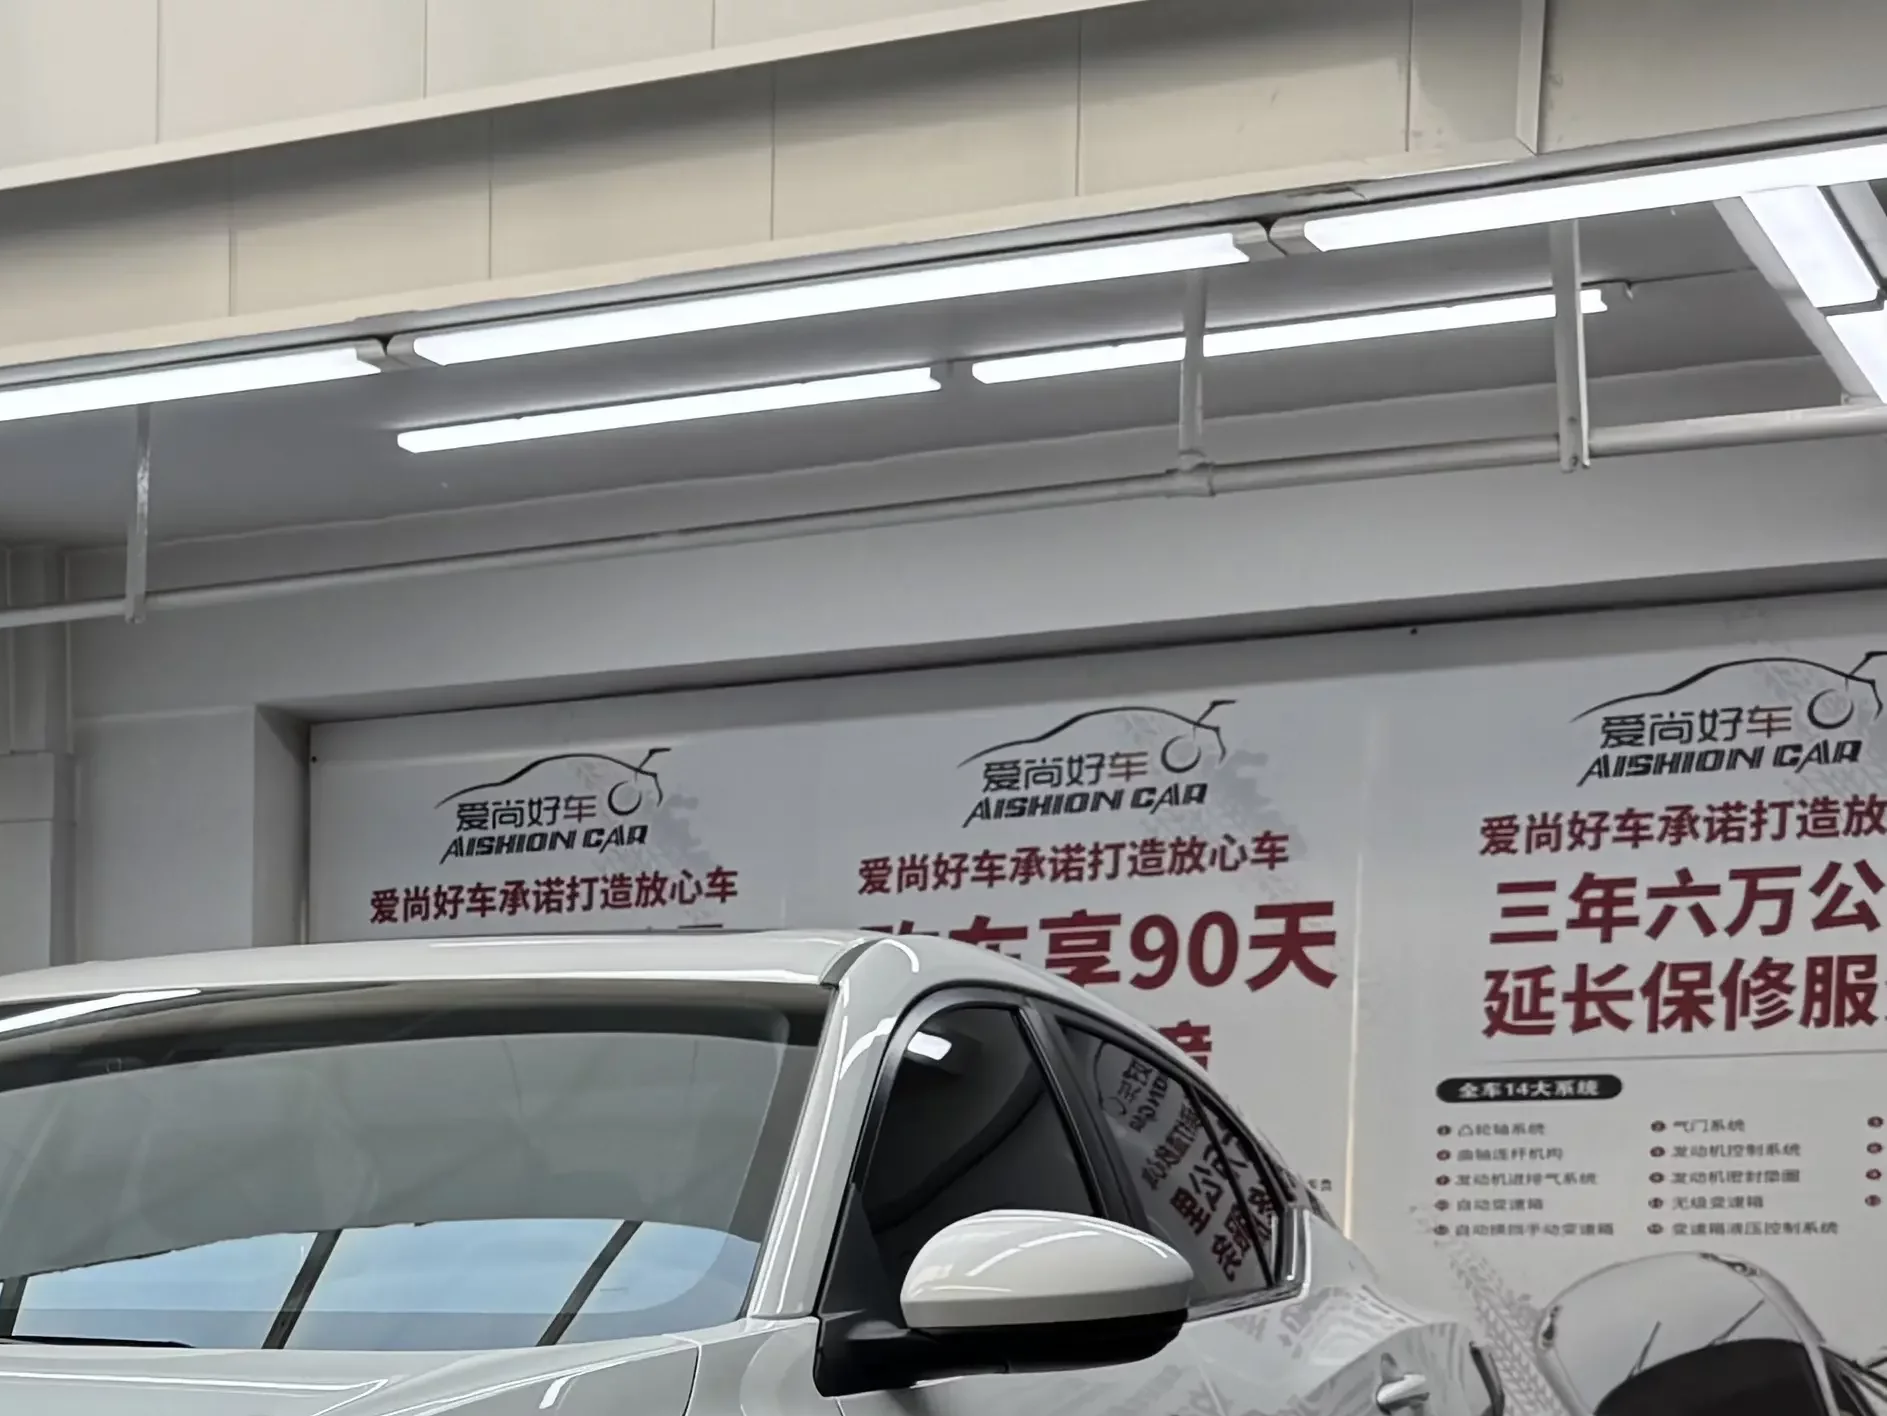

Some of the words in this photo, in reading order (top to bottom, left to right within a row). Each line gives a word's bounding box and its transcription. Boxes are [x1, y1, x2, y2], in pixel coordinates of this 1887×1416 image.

[1600, 705, 1792, 749] 爱尚好车
[981, 752, 1148, 793] 爱尚好车
[1577, 745, 1763, 787] AISHION
[1773, 739, 1863, 773] CAR
[455, 794, 596, 832] 爱尚好车
[962, 786, 1124, 827] AISHION
[1130, 783, 1208, 814] CAR
[1479, 793, 1887, 856] 爱尚好车承诺打造放
[439, 829, 576, 864] AISHION
[582, 824, 648, 854] CAR
[858, 831, 1289, 896] 爱尚好车承诺打造放心车
[370, 865, 738, 924] 爱尚好车承诺打造放心车
[1489, 859, 1886, 944] 三年六万公
[1483, 954, 1887, 1038] 延长保修服
[1458, 1080, 1600, 1098] 全车14大系统
[1672, 1119, 1745, 1133] 气门系统
